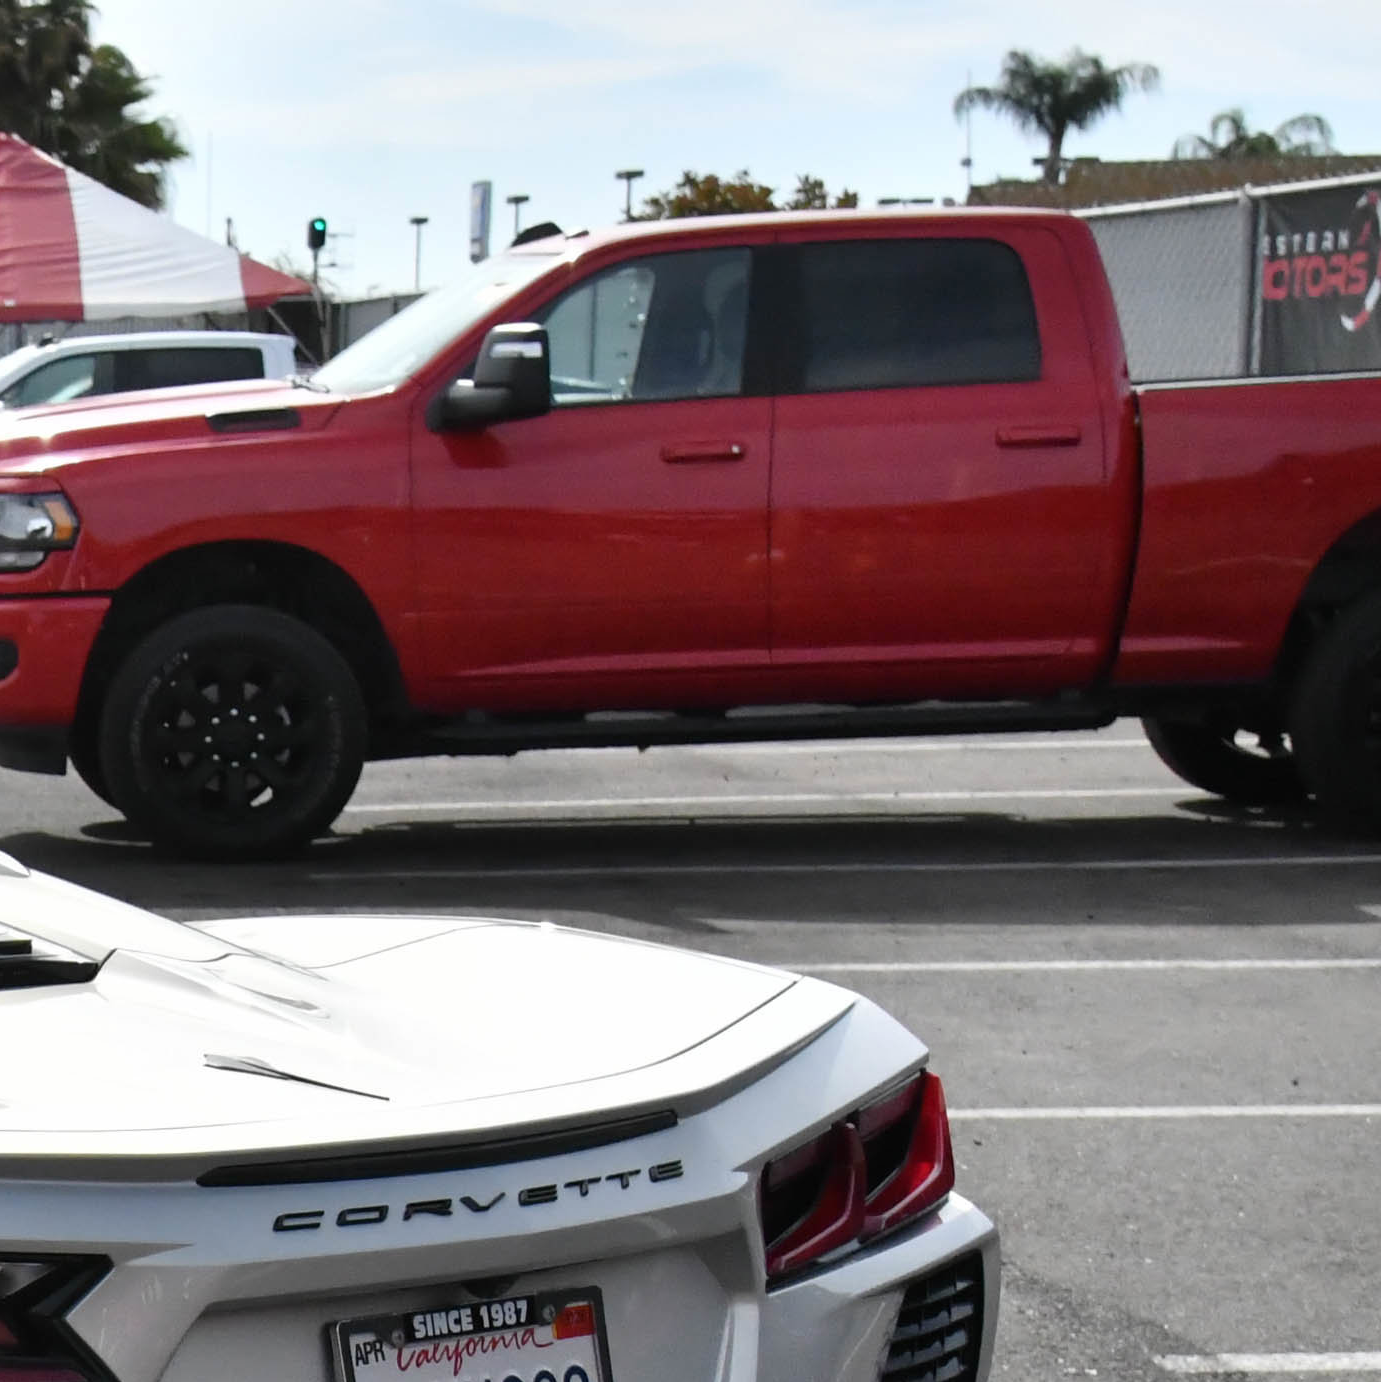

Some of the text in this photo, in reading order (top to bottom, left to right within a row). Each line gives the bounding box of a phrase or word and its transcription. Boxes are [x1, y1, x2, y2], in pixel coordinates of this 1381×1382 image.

[1262, 251, 1369, 300] OTORS
[273, 1160, 684, 1231] CORVETTE
[413, 1300, 528, 1338] SINCE 1987
[355, 1340, 385, 1366] APR
[396, 1328, 554, 1376] California
